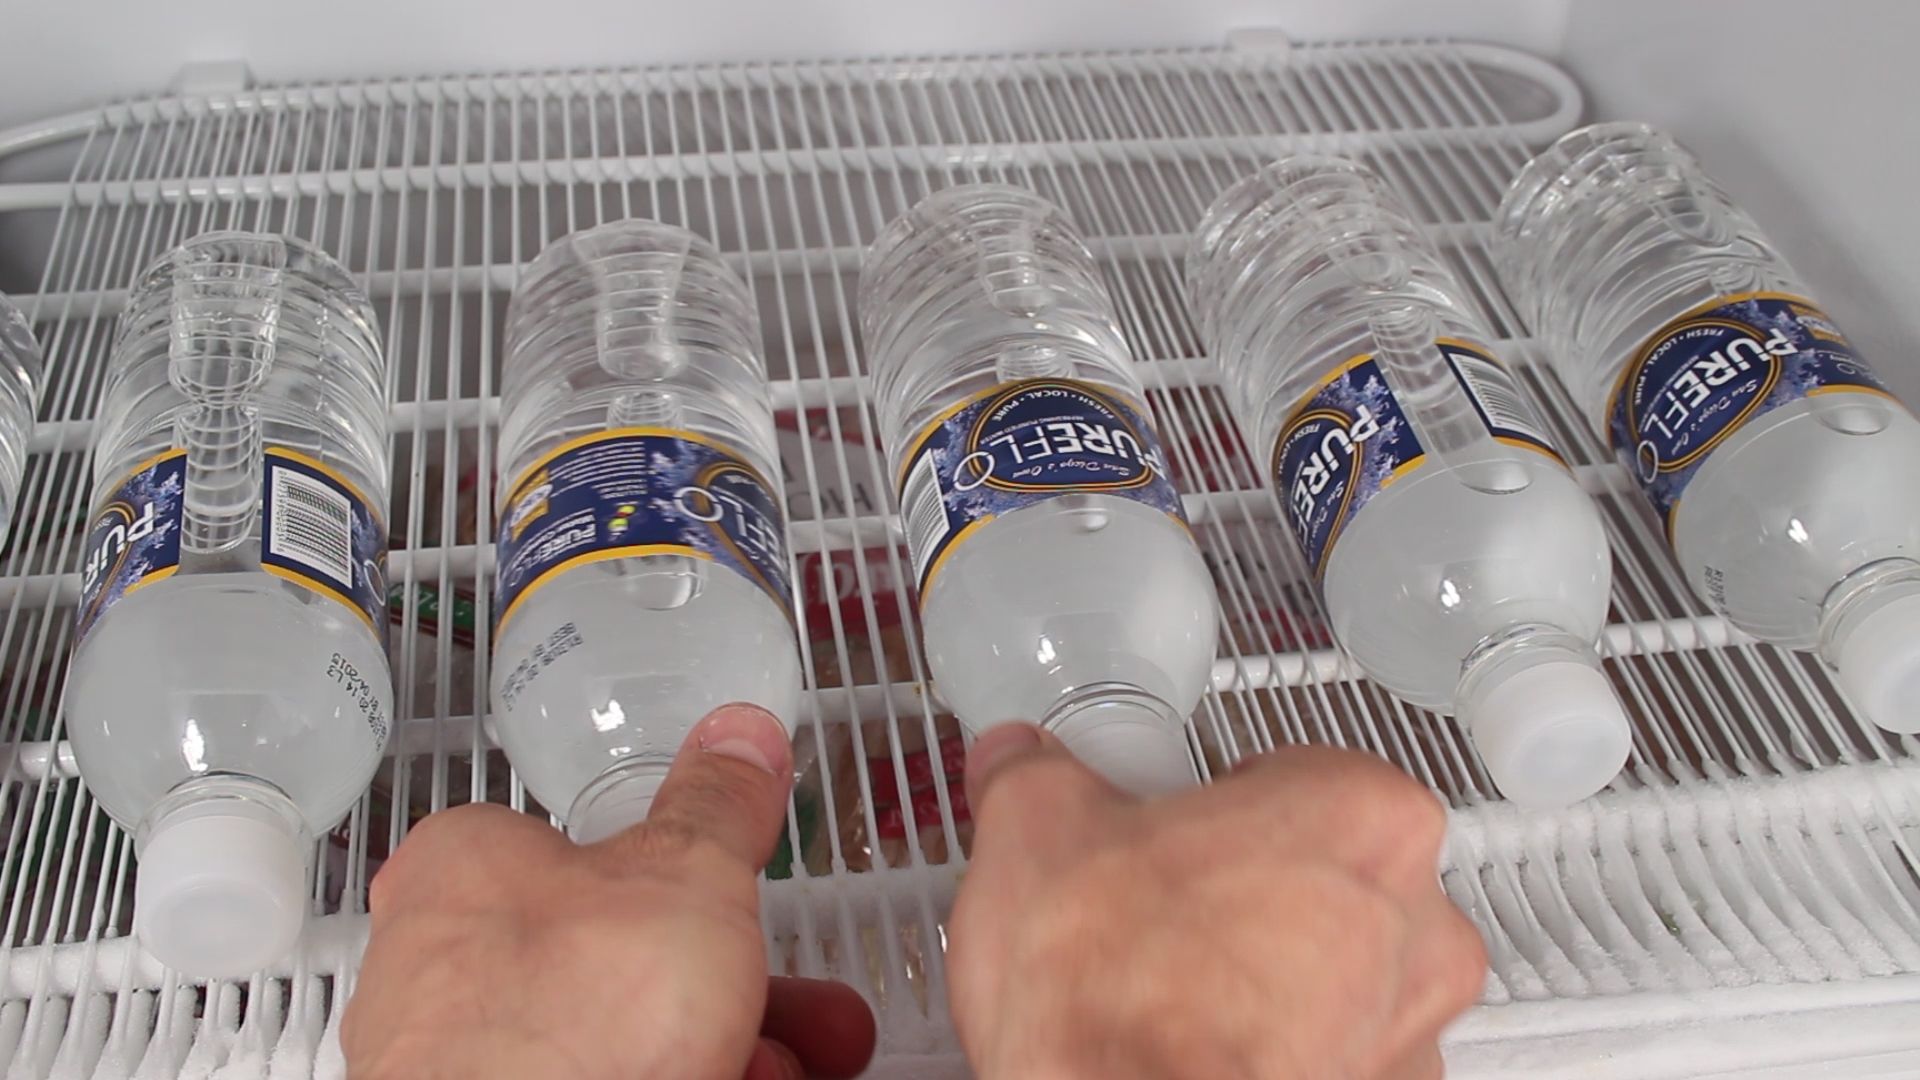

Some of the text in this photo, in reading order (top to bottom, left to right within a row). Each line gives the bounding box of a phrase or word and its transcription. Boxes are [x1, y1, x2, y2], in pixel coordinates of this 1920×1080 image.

[1634, 328, 1725, 405] FRESH LOCAL PURE
[1732, 379, 1758, 398] San
[991, 390, 1115, 421] FRESH LOCAL PURE
[1637, 327, 1798, 484] PUREFLO
[954, 422, 1168, 491] PUREFLO
[1047, 459, 1101, 474] Diego's
[1102, 462, 1131, 477] San
